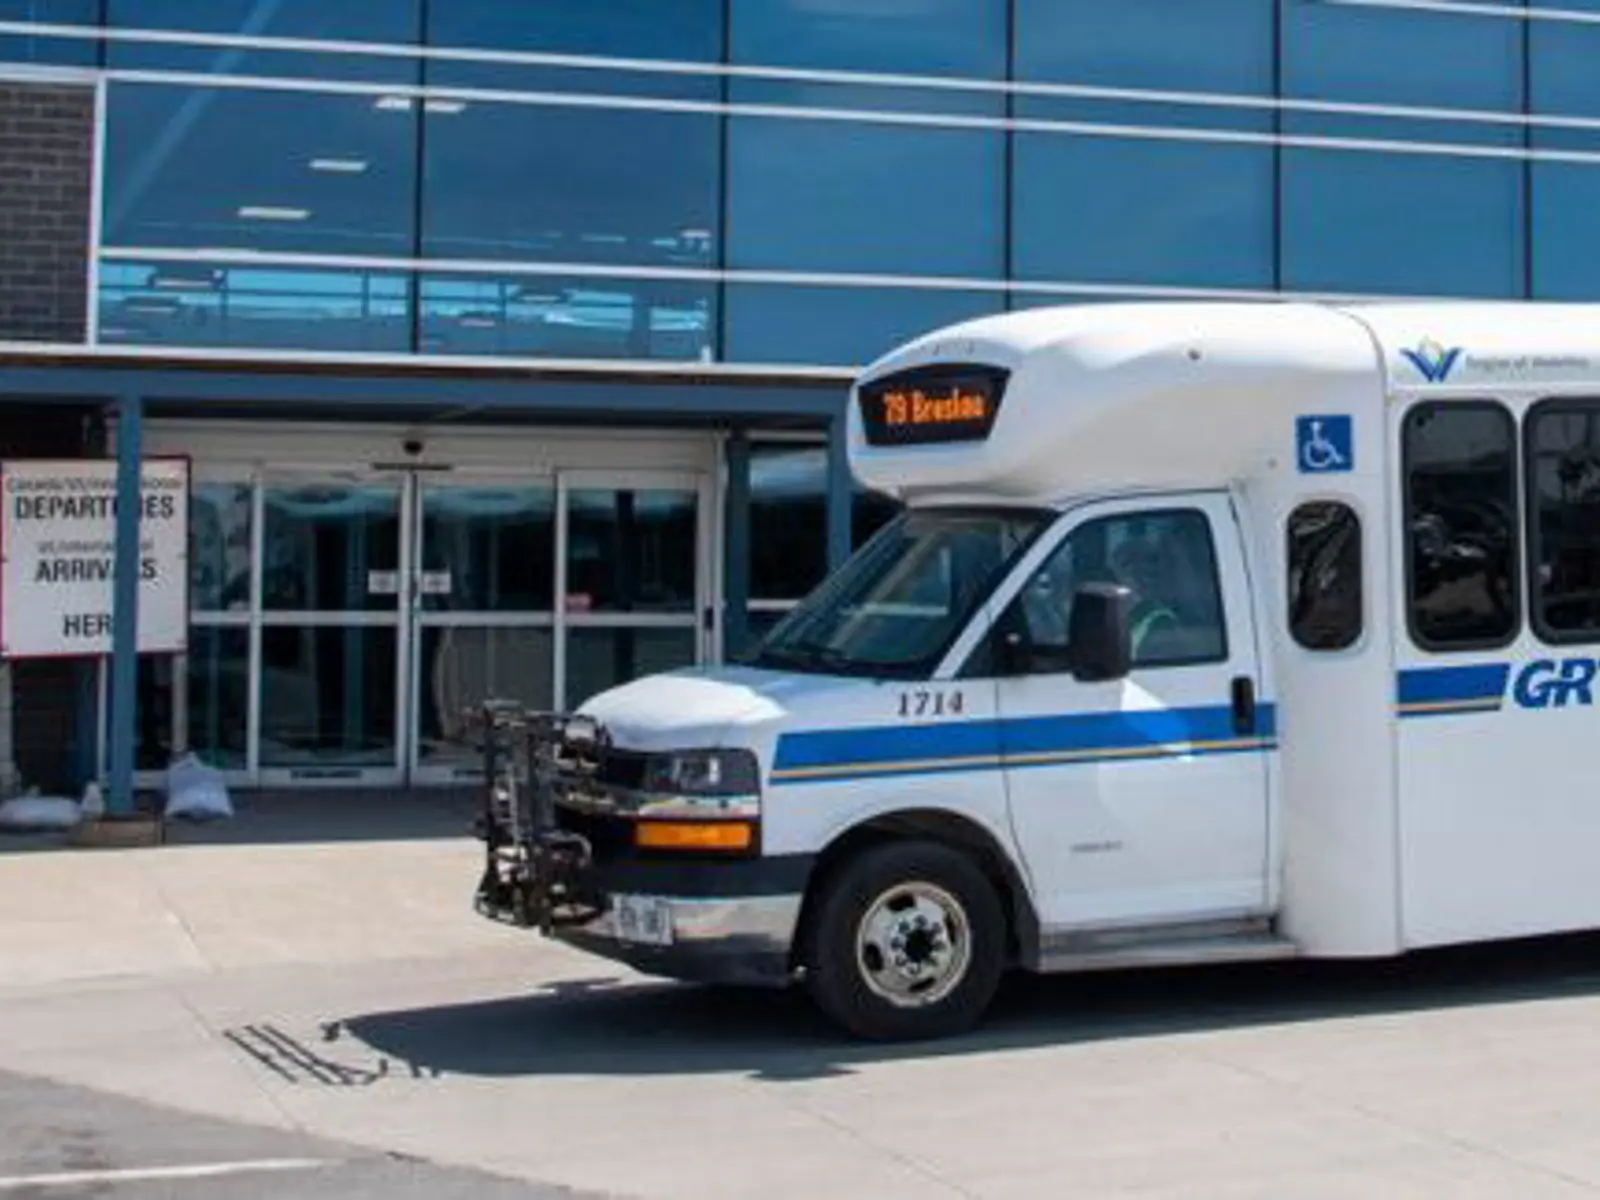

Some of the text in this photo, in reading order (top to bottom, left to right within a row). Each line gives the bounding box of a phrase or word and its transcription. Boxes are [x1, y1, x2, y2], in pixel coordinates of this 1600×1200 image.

[884, 391, 907, 424] 79
[15, 495, 174, 519] DEPARTES
[35, 558, 158, 582] ARRIVS
[1514, 658, 1600, 709] GR
[898, 691, 964, 717] 1714
